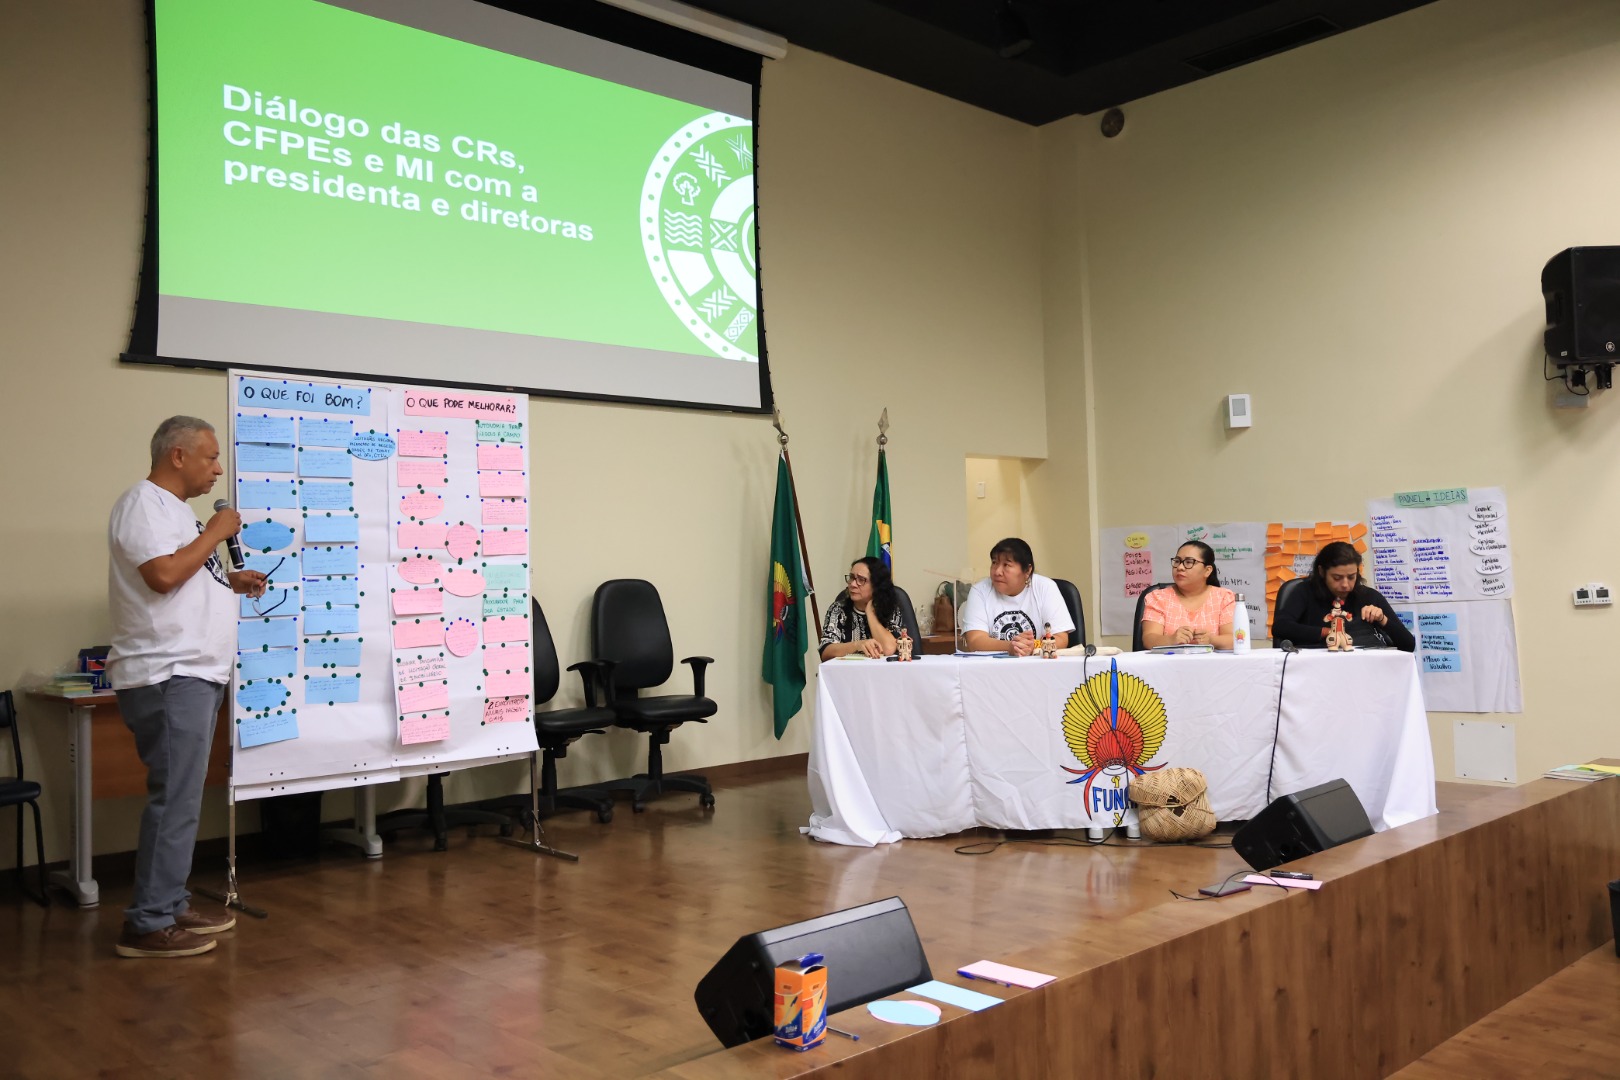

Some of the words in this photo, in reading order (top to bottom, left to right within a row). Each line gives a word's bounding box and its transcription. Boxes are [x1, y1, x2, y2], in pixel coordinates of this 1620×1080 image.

[223, 84, 370, 139] Diálogo
[381, 122, 442, 153] das
[452, 136, 525, 175] CRs,
[223, 120, 353, 168] CFPEs
[364, 154, 385, 173] e
[396, 154, 434, 184] MI
[445, 170, 512, 199] com
[521, 185, 539, 203] a
[224, 160, 421, 213] presidenta
[431, 198, 451, 217] e
[460, 200, 595, 243] diretoras
[243, 386, 255, 399] O
[260, 387, 289, 400] QUE
[296, 390, 315, 404] FOI
[406, 397, 416, 408] O
[419, 397, 439, 408] QUE
[443, 397, 464, 409] PODE
[468, 400, 516, 414] MELHORAR?
